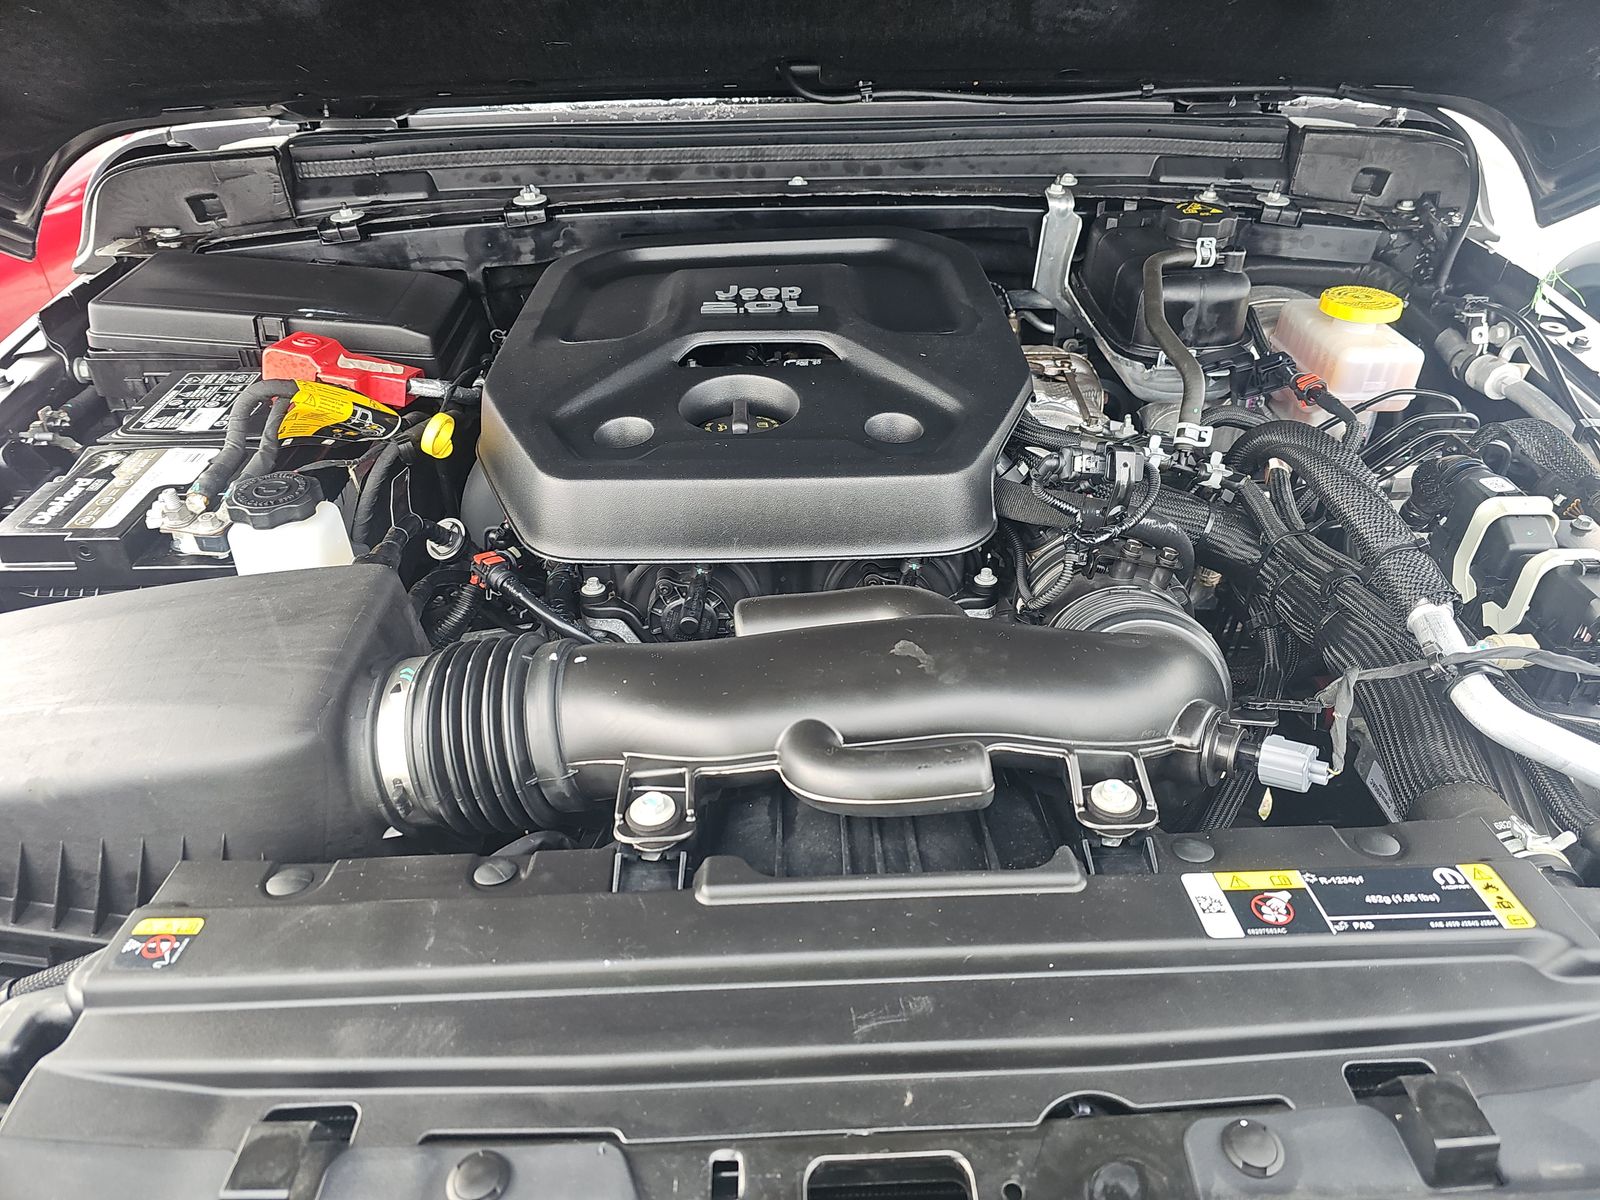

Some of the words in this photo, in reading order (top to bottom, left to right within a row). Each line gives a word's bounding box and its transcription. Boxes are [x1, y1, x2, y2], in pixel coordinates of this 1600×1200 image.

[714, 285, 803, 301] Jeep
[700, 300, 819, 314] 2.0L
[28, 477, 96, 525] DieHard
[1352, 921, 1375, 930] PAG
